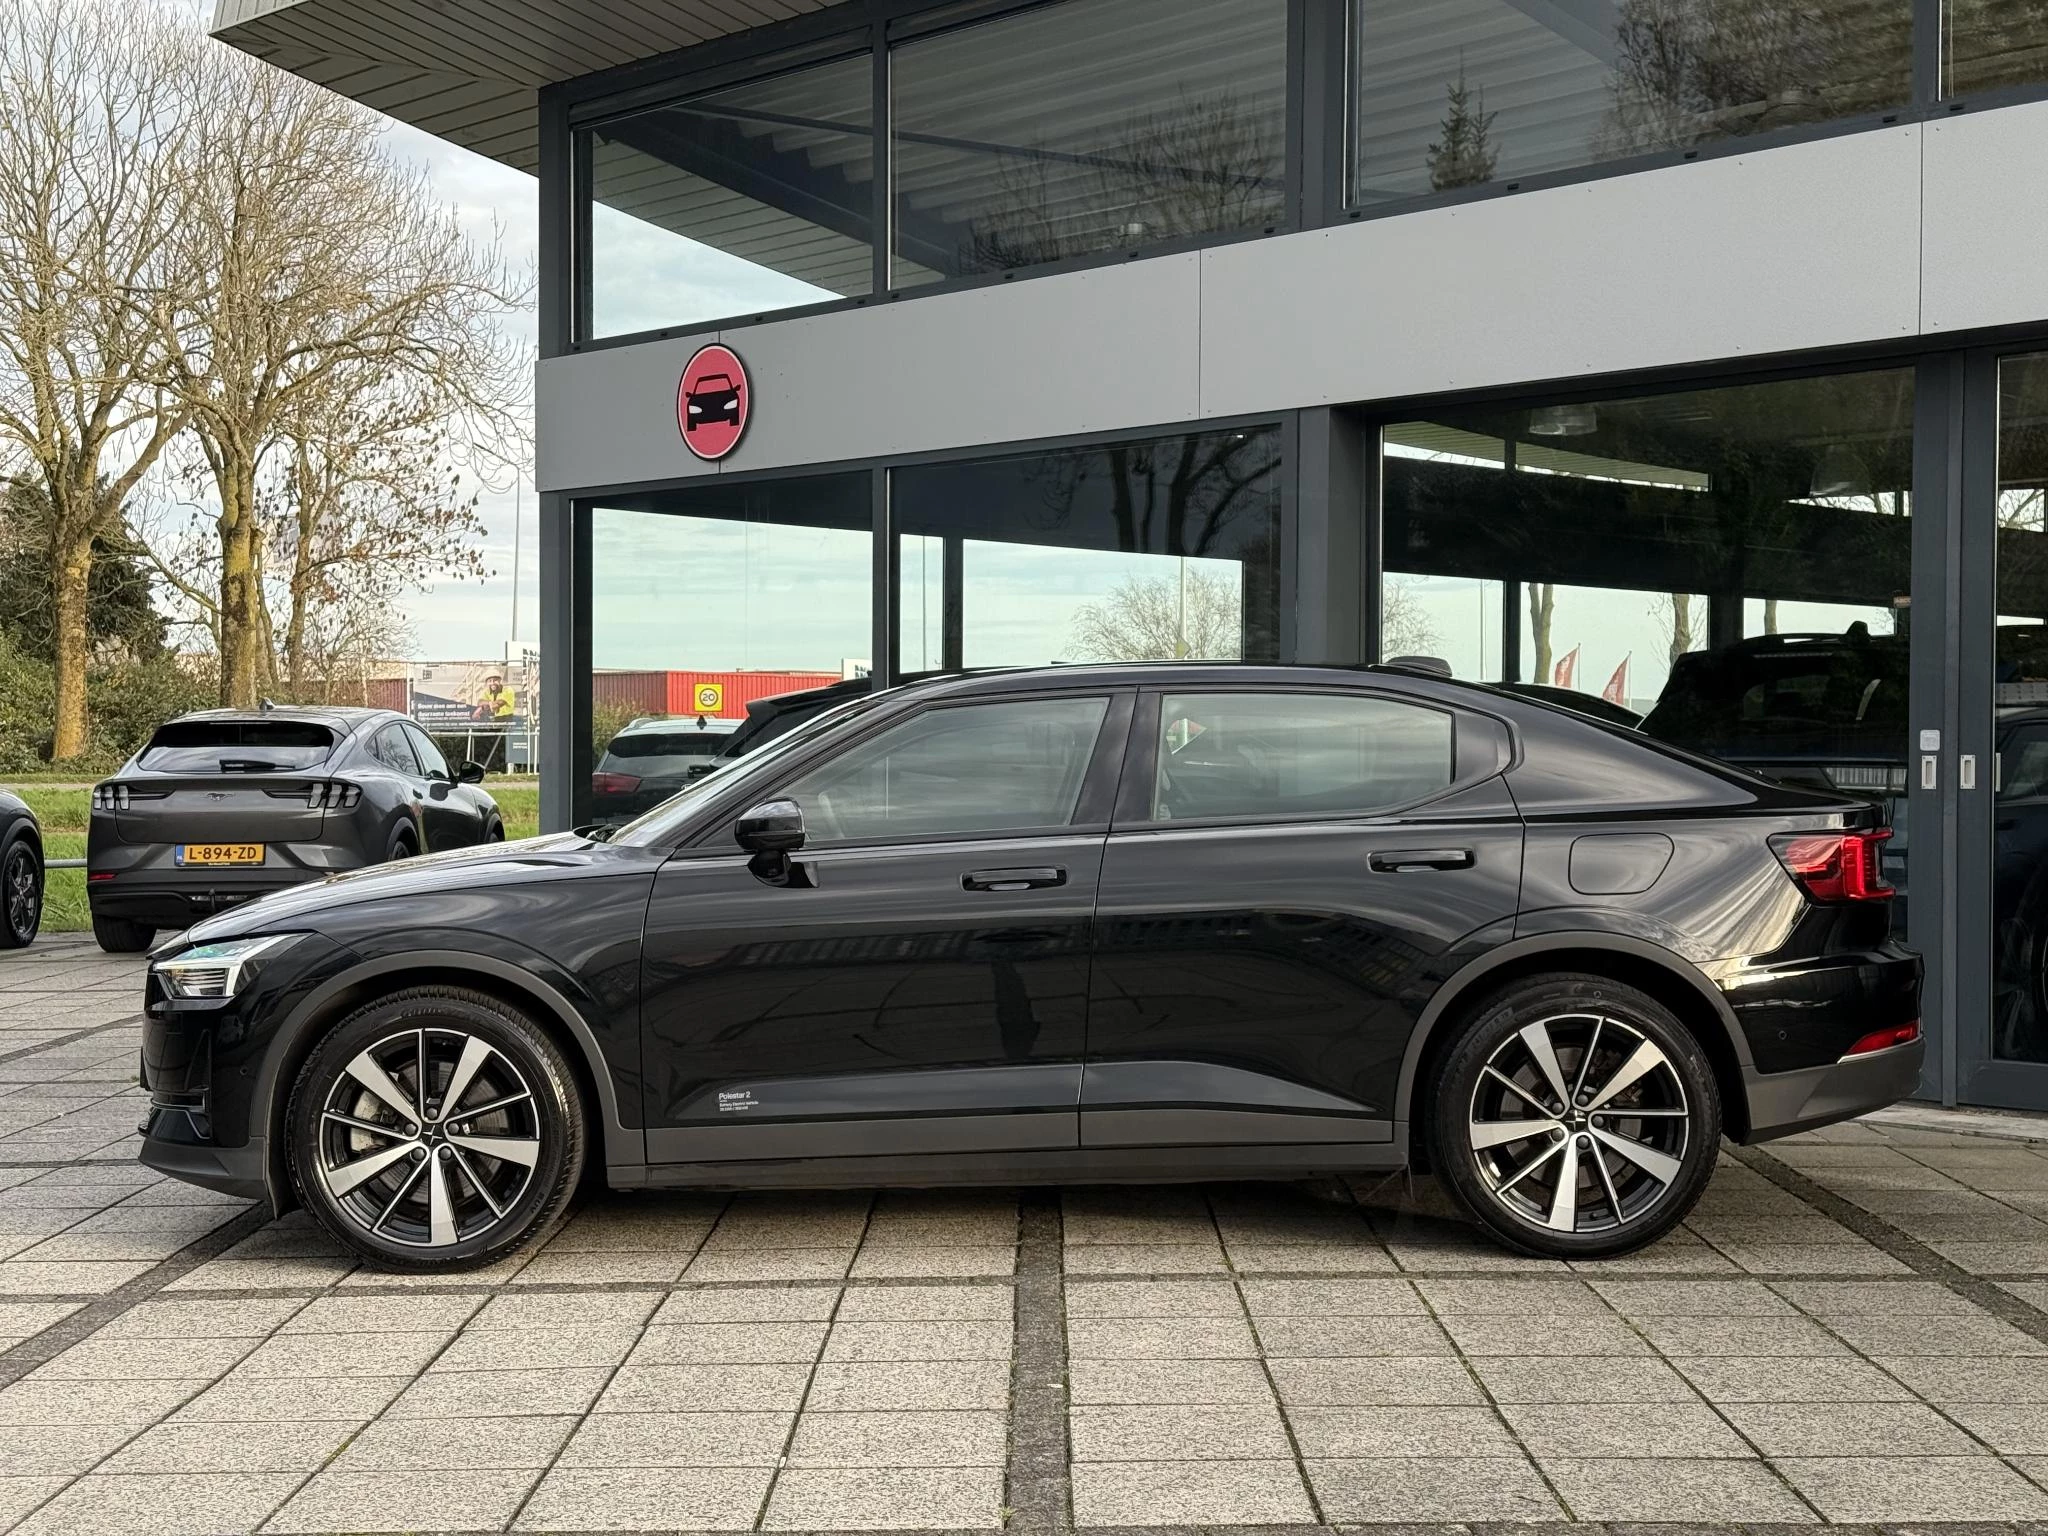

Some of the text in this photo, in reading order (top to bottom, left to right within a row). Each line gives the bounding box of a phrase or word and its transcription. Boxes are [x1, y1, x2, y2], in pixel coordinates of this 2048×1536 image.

[703, 693, 715, 701] 20
[189, 847, 256, 860] L-894-ZD
[719, 1092, 745, 1100] Polestar
